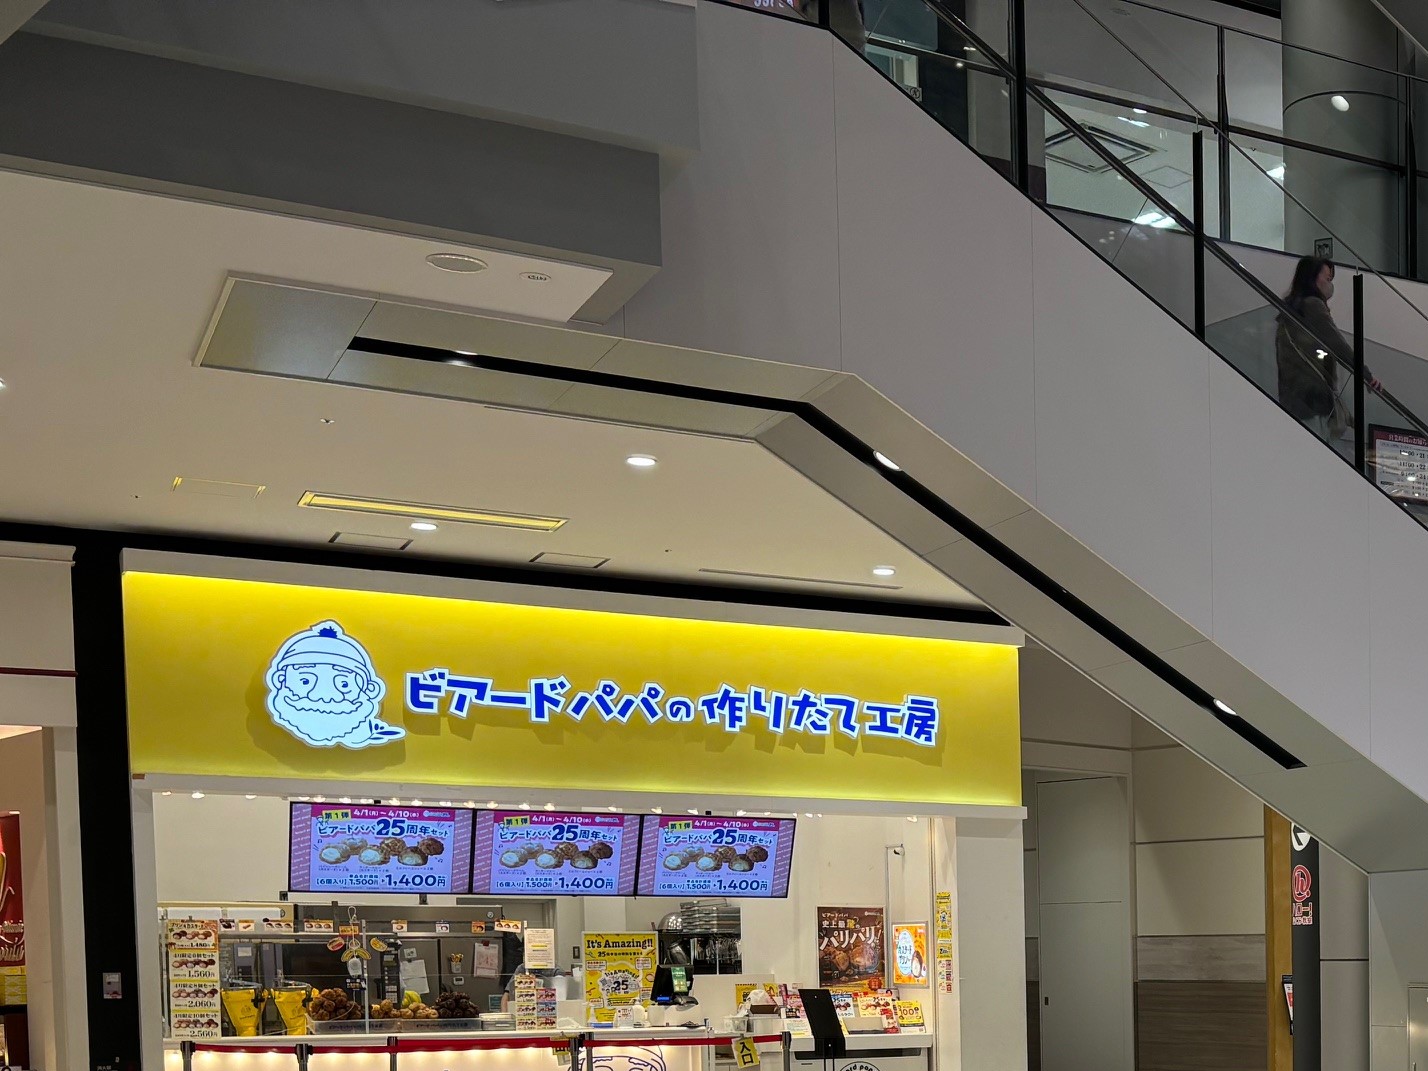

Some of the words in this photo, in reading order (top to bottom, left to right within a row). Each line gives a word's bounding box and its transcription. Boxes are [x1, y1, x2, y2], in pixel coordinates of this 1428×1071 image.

[409, 670, 938, 744] ビアードパパの作りたて工房
[586, 939, 602, 949] It's
[604, 938, 653, 950] Amazing!!
[739, 1041, 754, 1065] 入口
